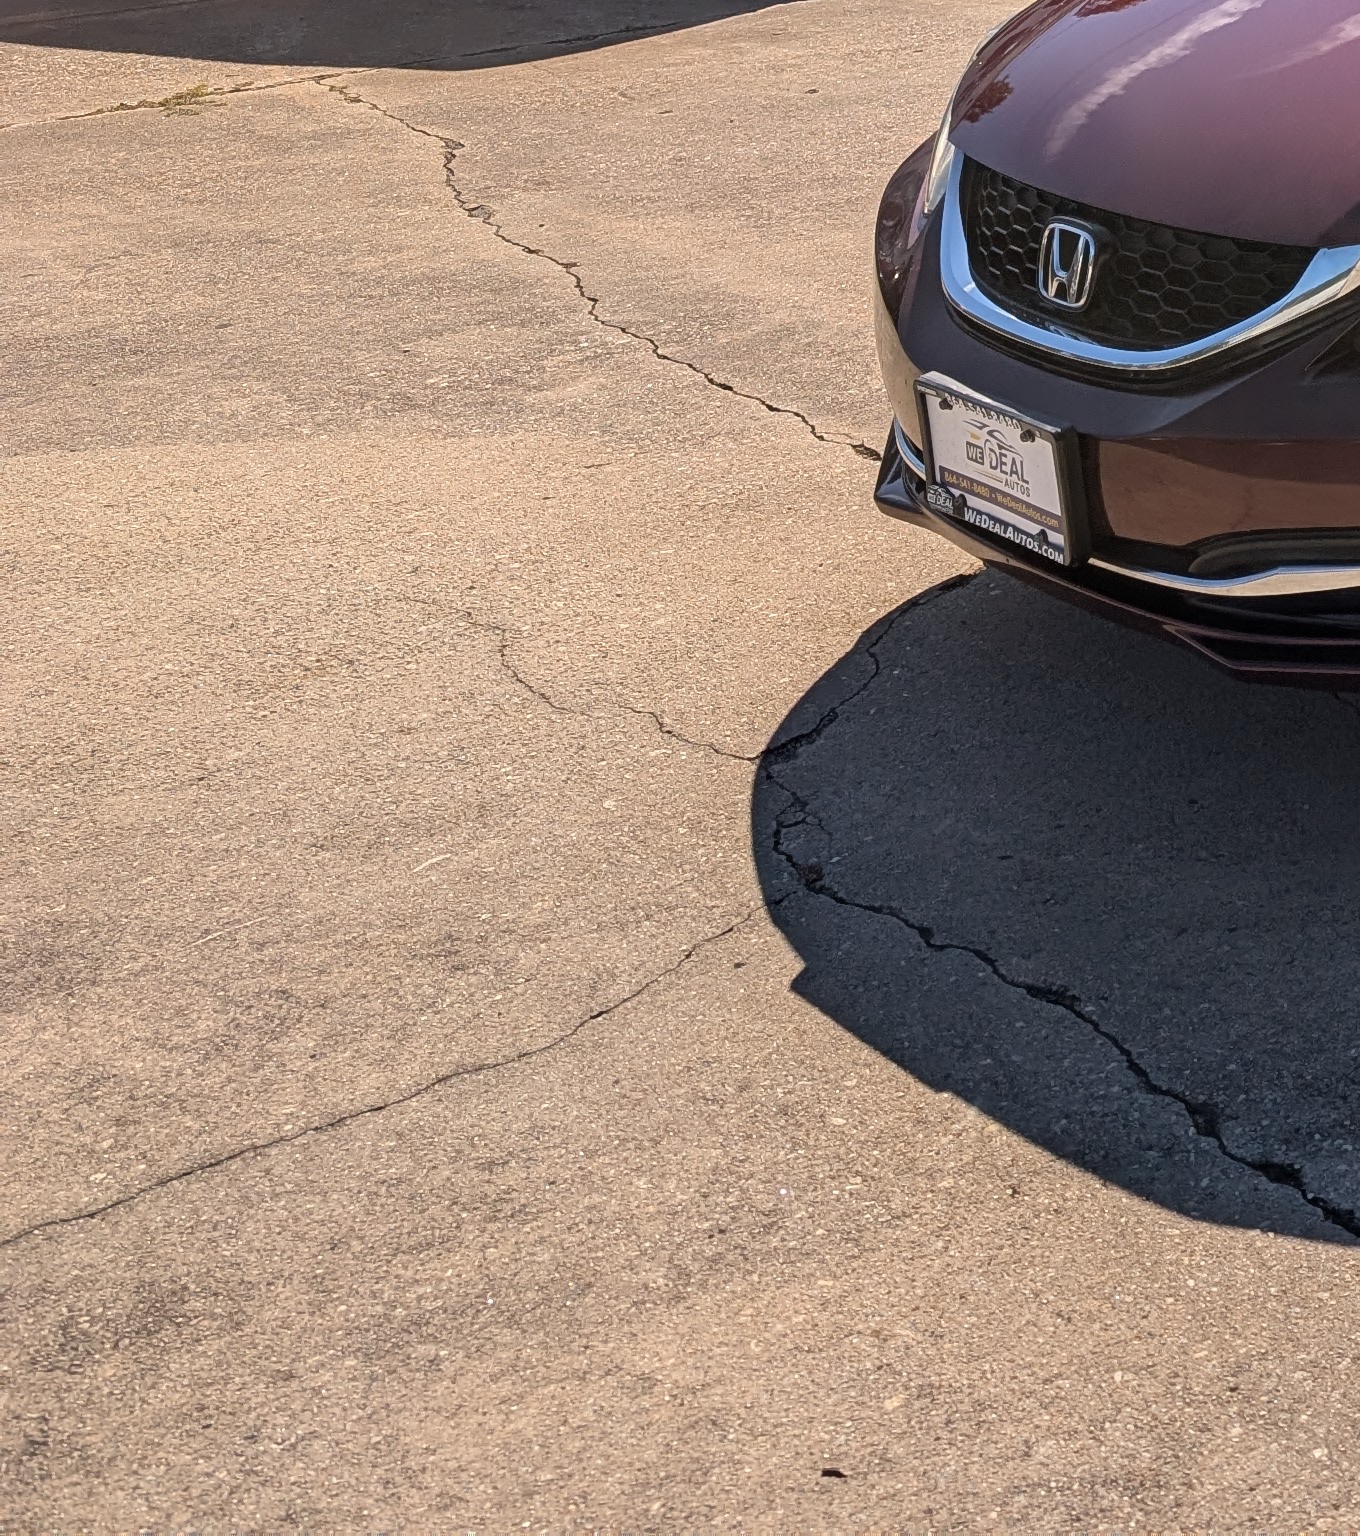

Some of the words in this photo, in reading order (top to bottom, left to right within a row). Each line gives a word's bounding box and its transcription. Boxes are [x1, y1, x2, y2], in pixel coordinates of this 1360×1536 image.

[966, 443, 984, 462] WE
[988, 448, 1030, 485] DEAL
[1003, 477, 1031, 498] AUTOS
